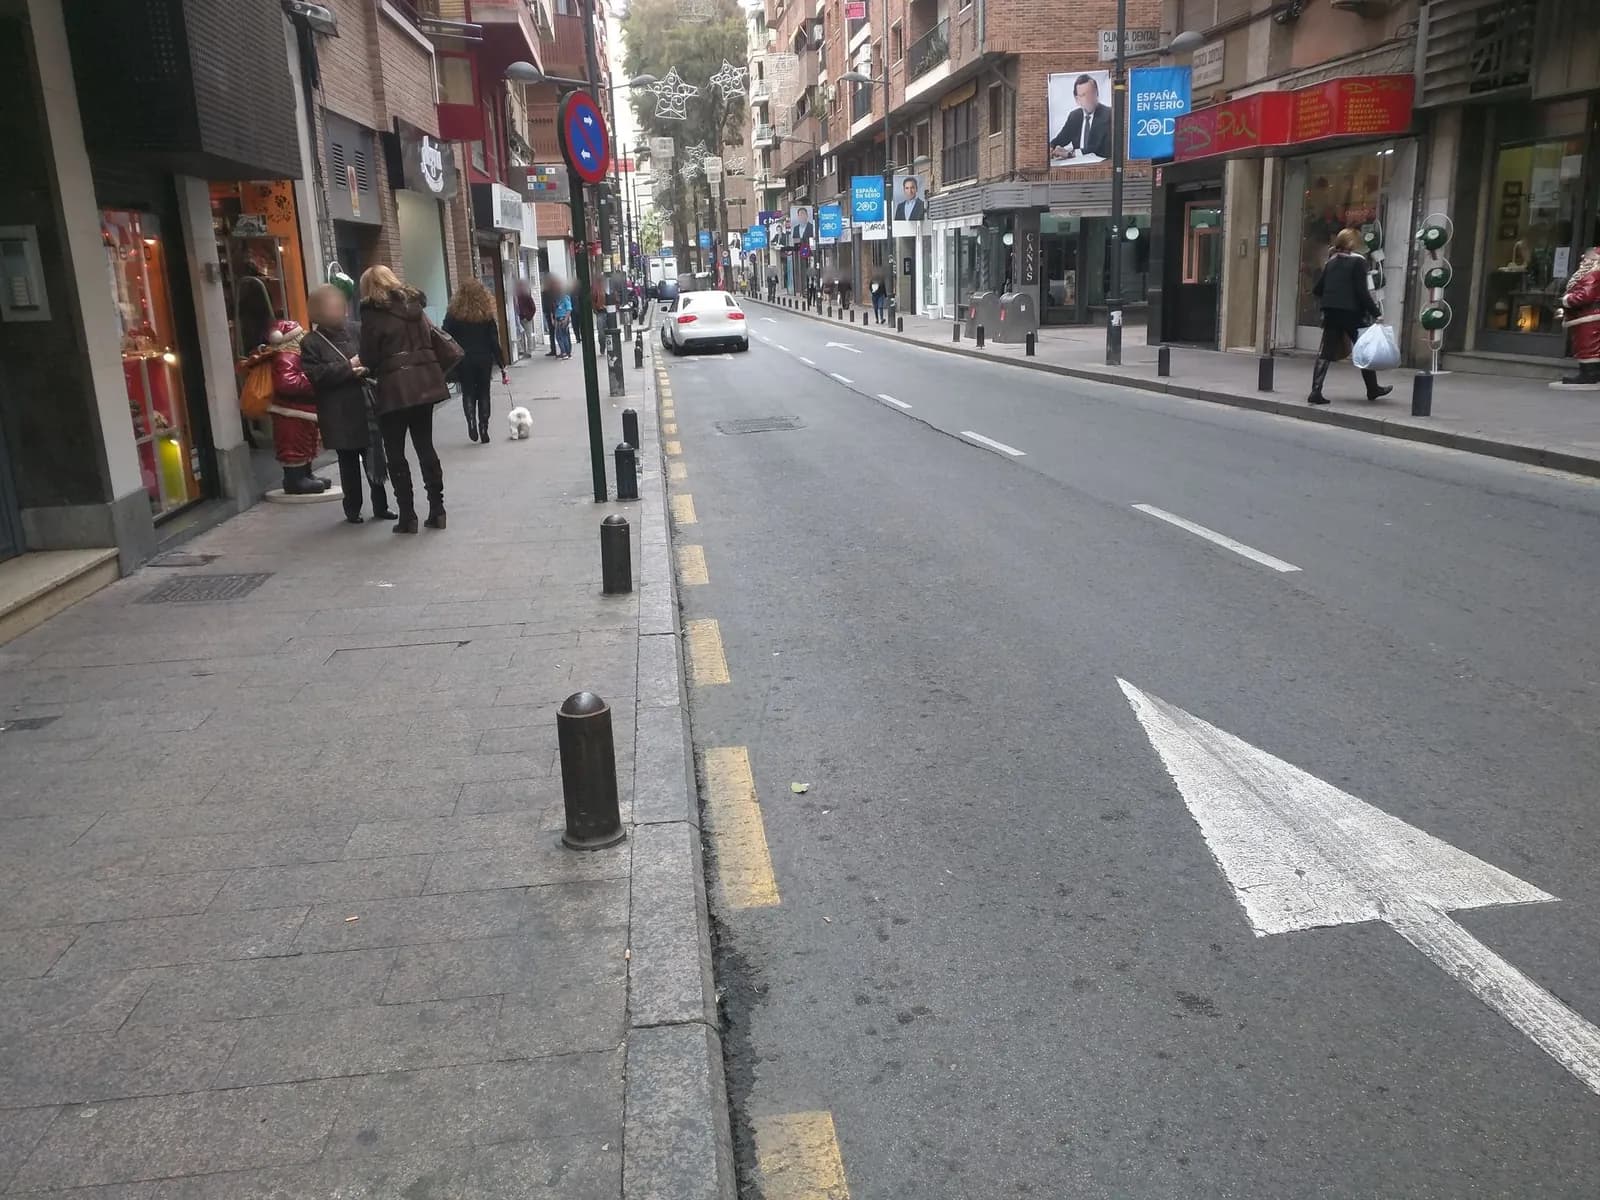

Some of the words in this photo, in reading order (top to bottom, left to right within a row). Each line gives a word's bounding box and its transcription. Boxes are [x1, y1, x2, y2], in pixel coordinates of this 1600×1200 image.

[1104, 31, 1130, 43] CLINA
[1137, 90, 1177, 101] ESPAÑA
[1137, 102, 1149, 111] EN
[1153, 100, 1184, 110] SERIO
